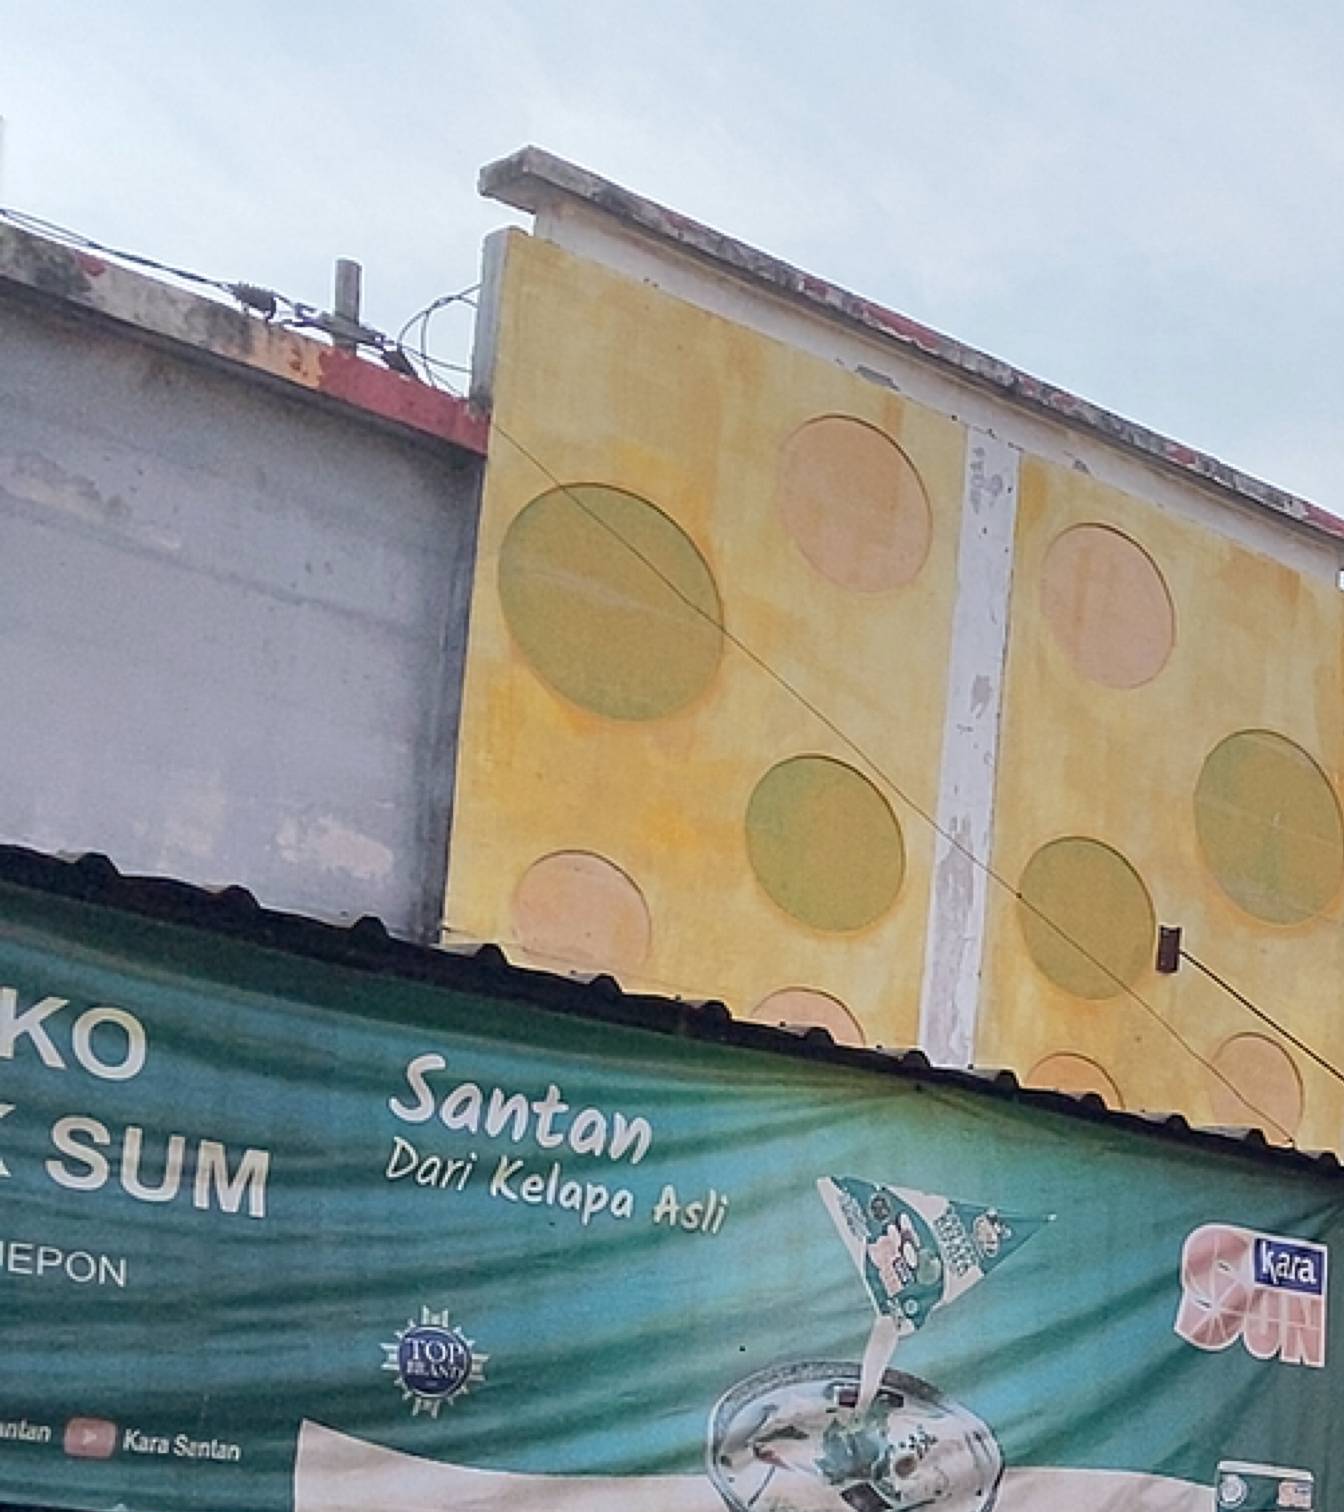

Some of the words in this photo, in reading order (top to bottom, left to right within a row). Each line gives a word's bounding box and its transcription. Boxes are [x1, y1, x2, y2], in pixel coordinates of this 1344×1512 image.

[388, 1053, 652, 1165] Santan
[45, 1113, 270, 1219] SUM
[385, 1135, 477, 1191] Dari
[489, 1153, 634, 1226] Kelapa
[652, 1183, 730, 1234] Asli
[1261, 1240, 1318, 1285] kara
[404, 1336, 465, 1364] TOP
[123, 1427, 170, 1457] Kara
[173, 1433, 242, 1462] Santan
